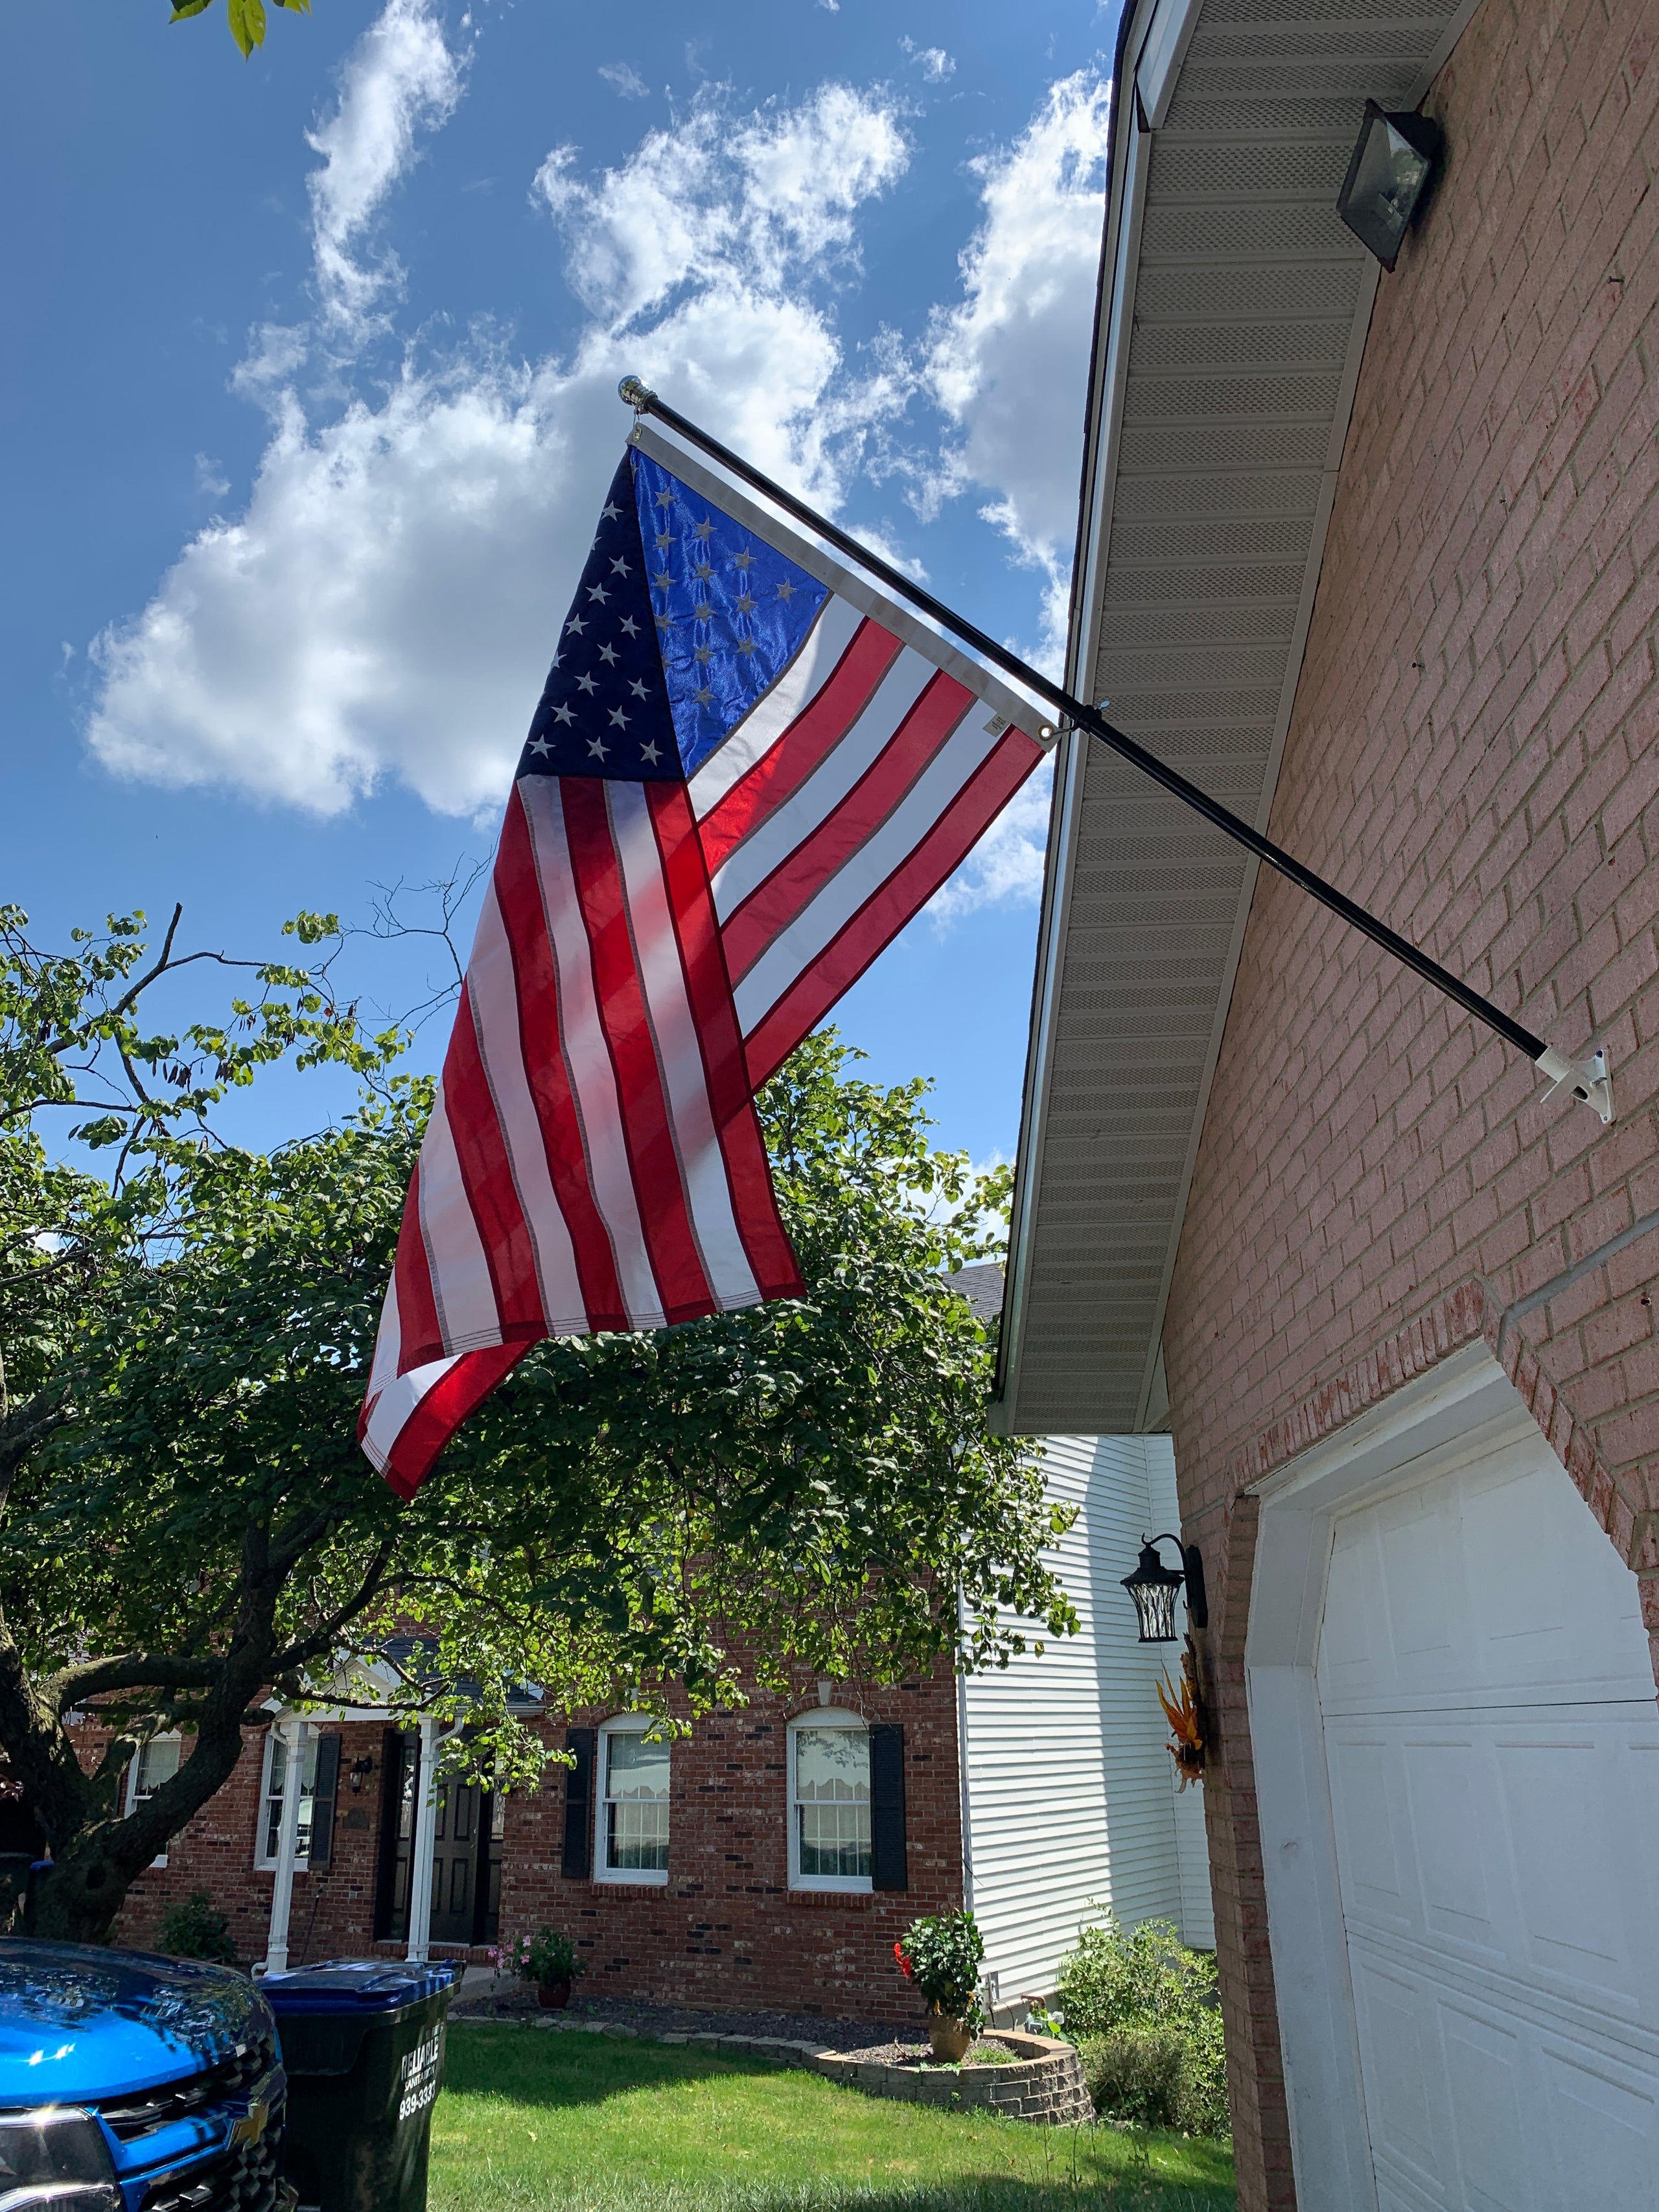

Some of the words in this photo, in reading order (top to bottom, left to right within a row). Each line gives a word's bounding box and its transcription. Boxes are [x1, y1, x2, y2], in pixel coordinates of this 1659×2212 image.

[401, 2036, 439, 2080] RELIABLE
[404, 2064, 435, 2092] SANITATION
[399, 2080, 436, 2121] 939-3333
